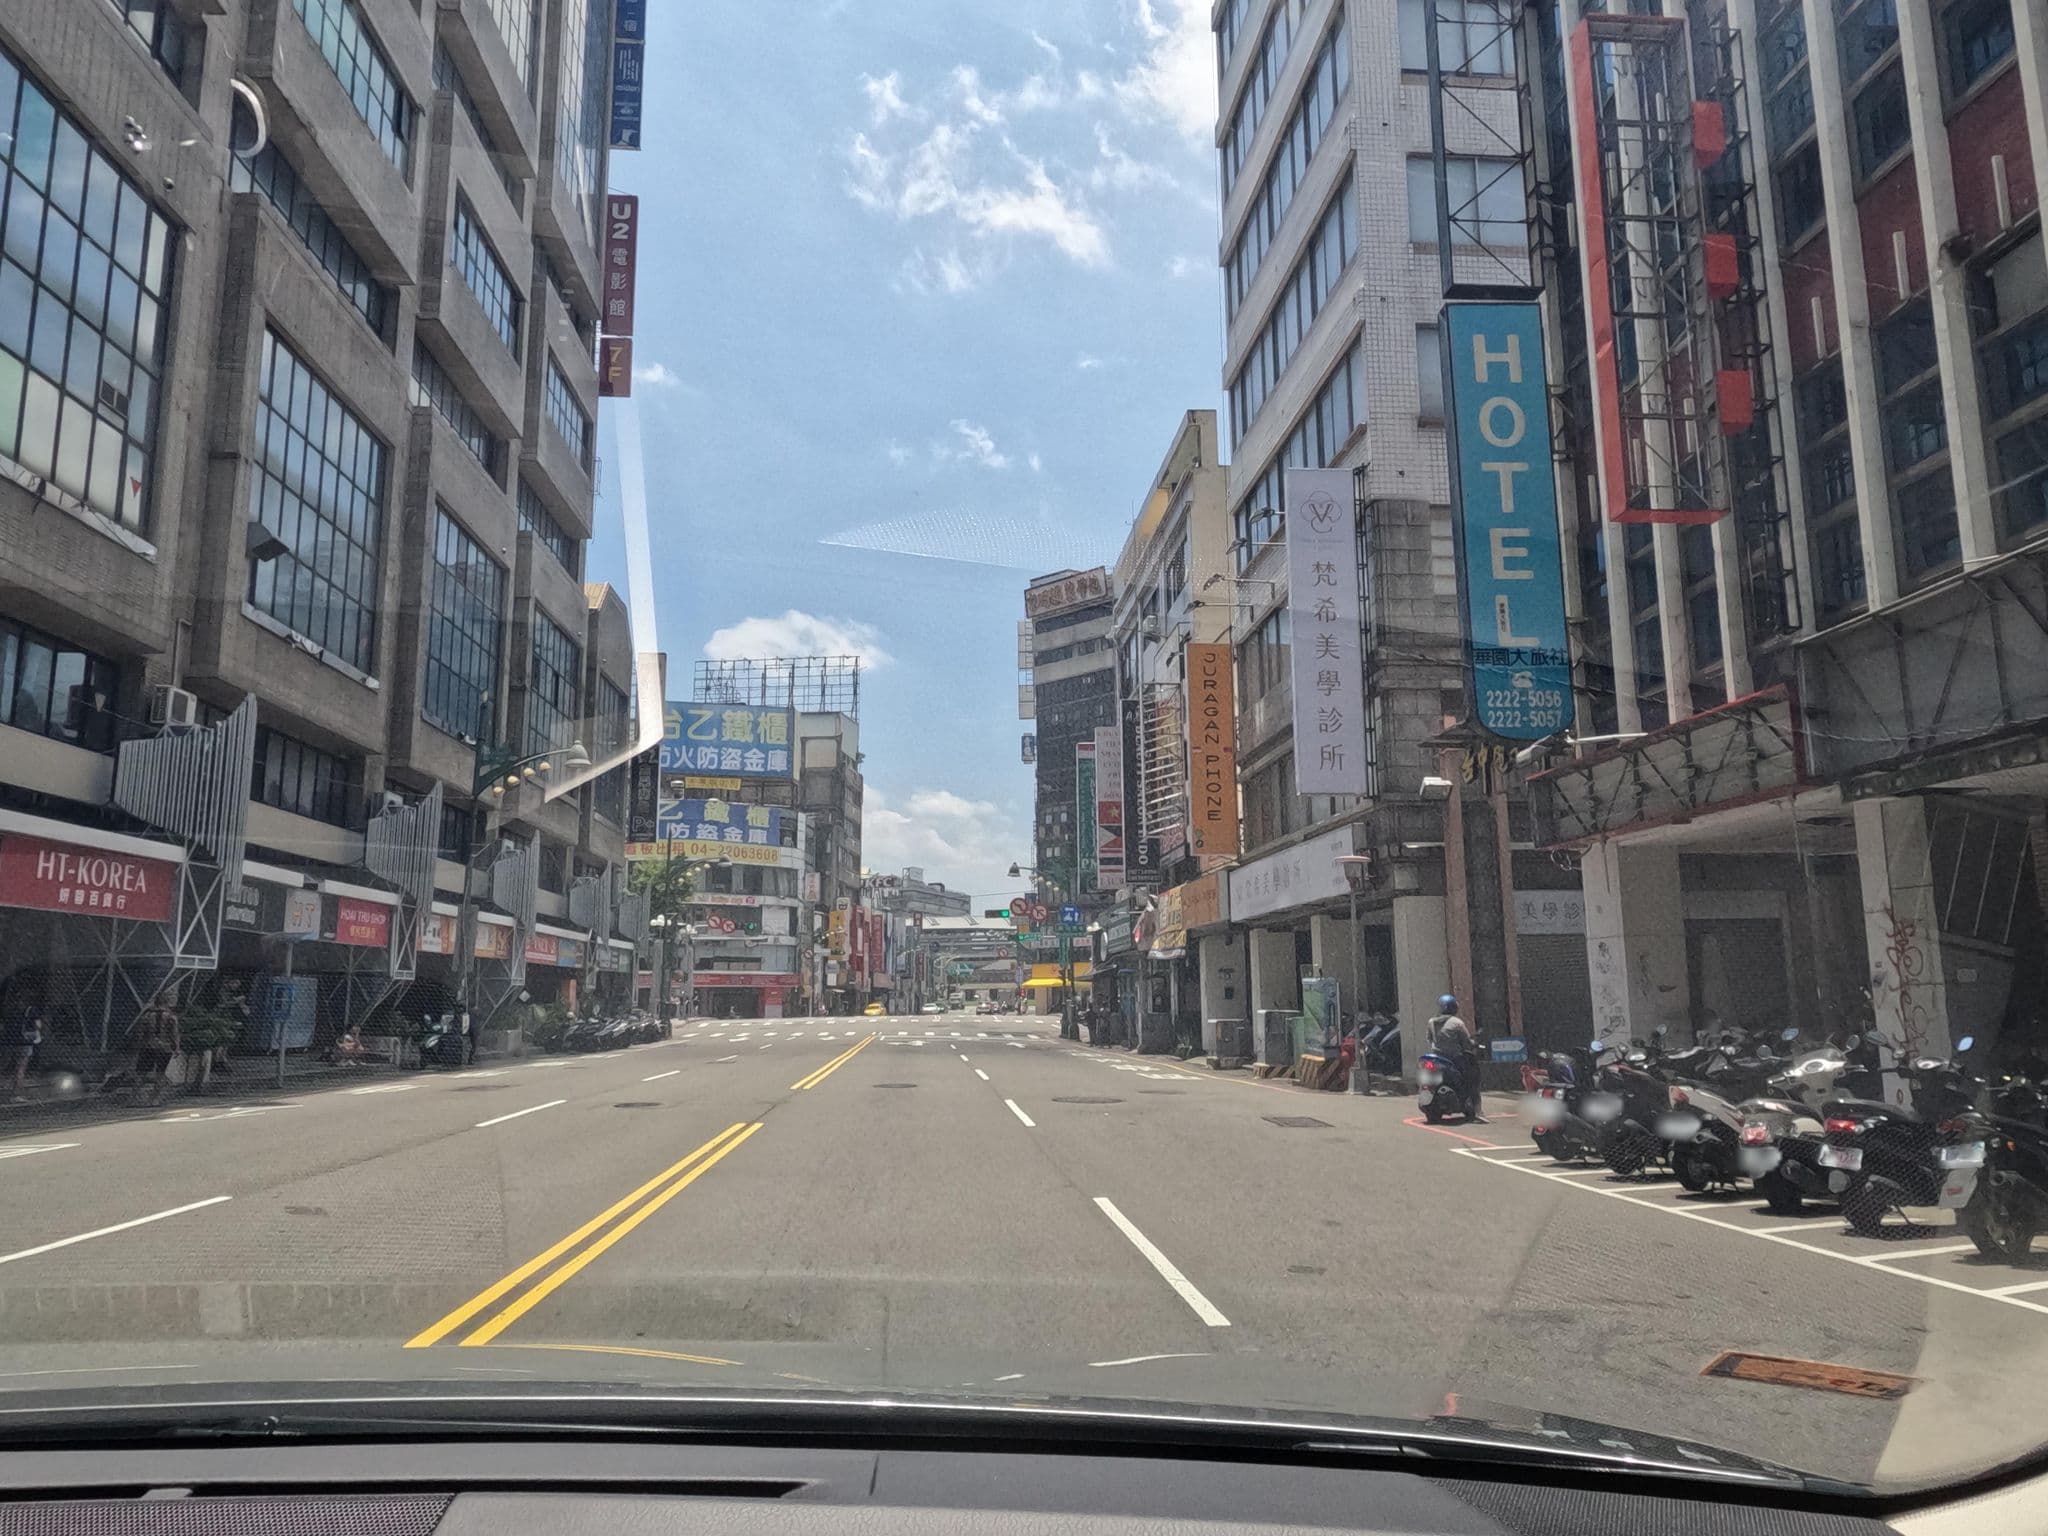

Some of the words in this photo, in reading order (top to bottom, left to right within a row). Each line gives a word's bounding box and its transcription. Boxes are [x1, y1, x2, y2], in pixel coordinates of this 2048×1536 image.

[1472, 333, 1540, 647] HOTEL
[1311, 561, 1345, 772] 梵希美學診所
[1202, 652, 1220, 745] JURAGAN
[1486, 689, 1562, 708] 2222-5056
[1487, 709, 1562, 728] 2222-5057
[1205, 754, 1223, 822] PHONE
[36, 849, 147, 894] HT-KOREA
[865, 877, 892, 888] KFC
[1520, 902, 1583, 920] 美學診
